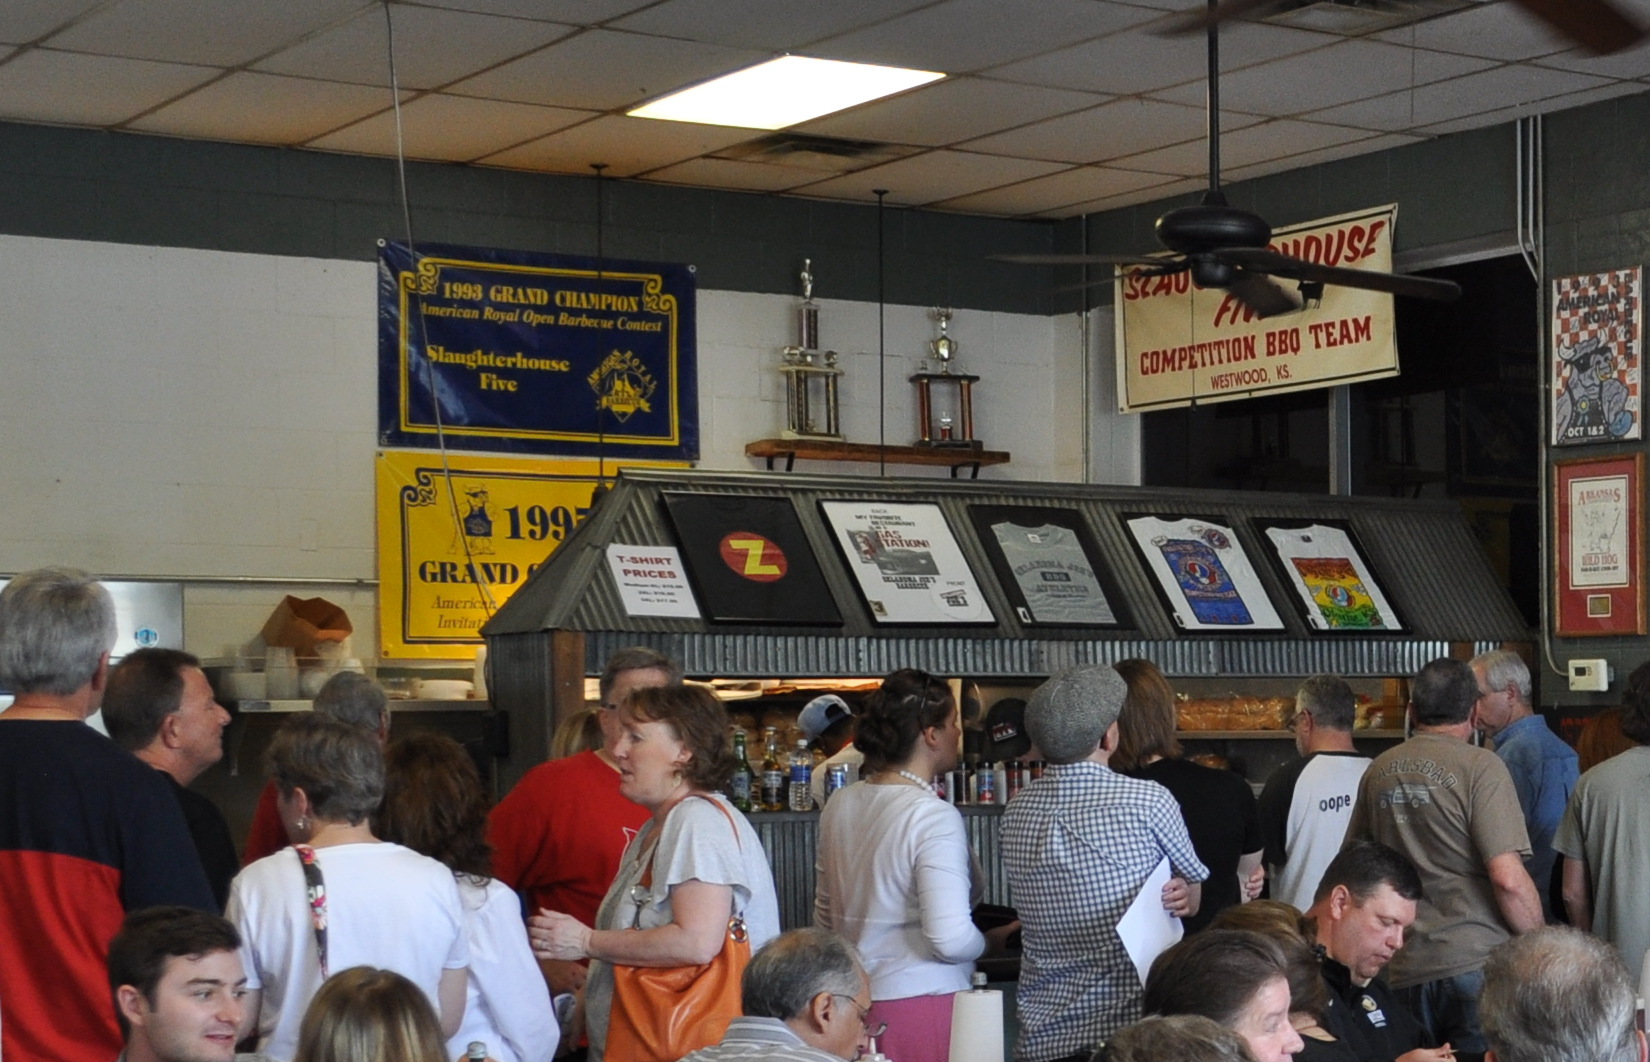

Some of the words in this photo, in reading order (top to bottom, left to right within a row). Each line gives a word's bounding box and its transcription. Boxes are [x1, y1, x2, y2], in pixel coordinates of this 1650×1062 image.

[443, 281, 483, 300] 1993
[490, 286, 548, 306] GRAND
[555, 290, 639, 313] CHAMPION
[1557, 291, 1622, 313] AMERICAN
[420, 301, 479, 320] American
[483, 306, 519, 324] Royal
[523, 309, 555, 327] Open
[558, 313, 614, 330] Barbecue
[617, 316, 662, 332] Contest
[1583, 308, 1620, 326] ROYAL
[1140, 335, 1256, 376] COMPETITION
[1265, 327, 1301, 356] BBQ
[1308, 315, 1372, 351] TEAM
[426, 345, 571, 372] Slaughterhouse
[479, 373, 518, 391] Five
[1211, 367, 1271, 390] WESTWOOD,
[1276, 364, 1293, 380] KS.
[1567, 426, 1584, 438] OCT
[1578, 488, 1621, 506] ARKANSAS
[879, 539, 930, 548] TATION!
[616, 555, 672, 565] T-SHIRT
[728, 540, 781, 576] Z
[1602, 554, 1618, 565] HOG
[418, 560, 520, 585] GRAND
[622, 568, 677, 579] PRICES
[431, 595, 498, 611] American
[1319, 794, 1351, 812] oope
